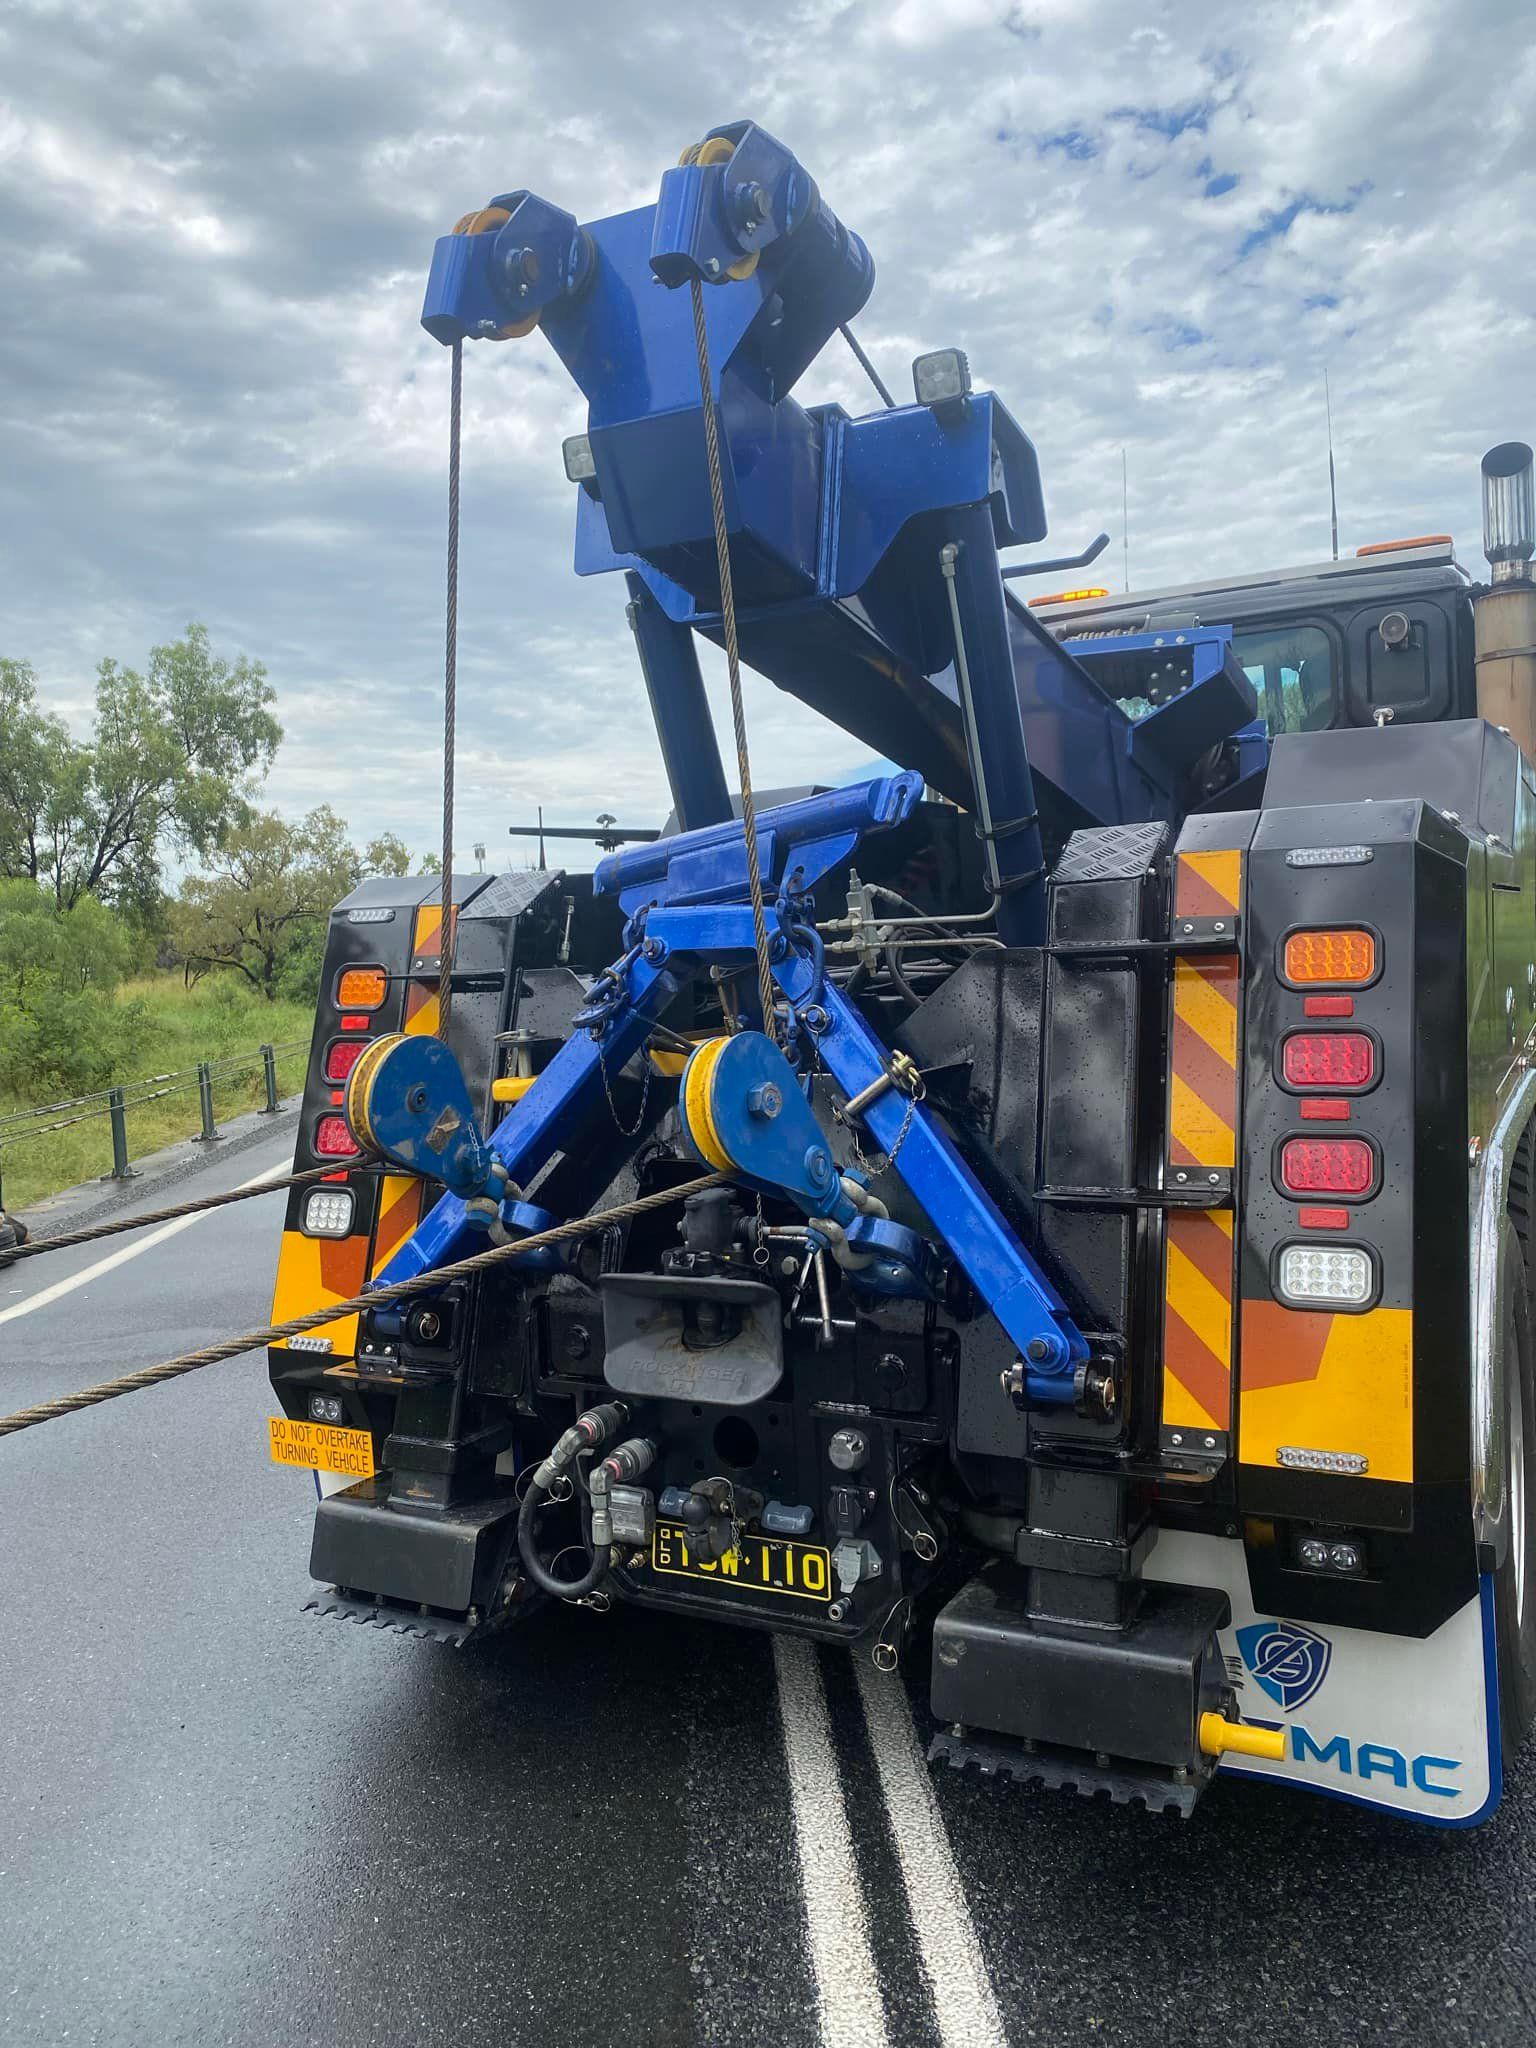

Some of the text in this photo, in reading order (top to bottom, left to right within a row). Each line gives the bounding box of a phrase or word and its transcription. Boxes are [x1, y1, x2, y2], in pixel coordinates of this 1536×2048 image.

[271, 1420, 370, 1452] DO NOT OVERTAKE
[274, 1441, 370, 1474] TURNING VEHICLE
